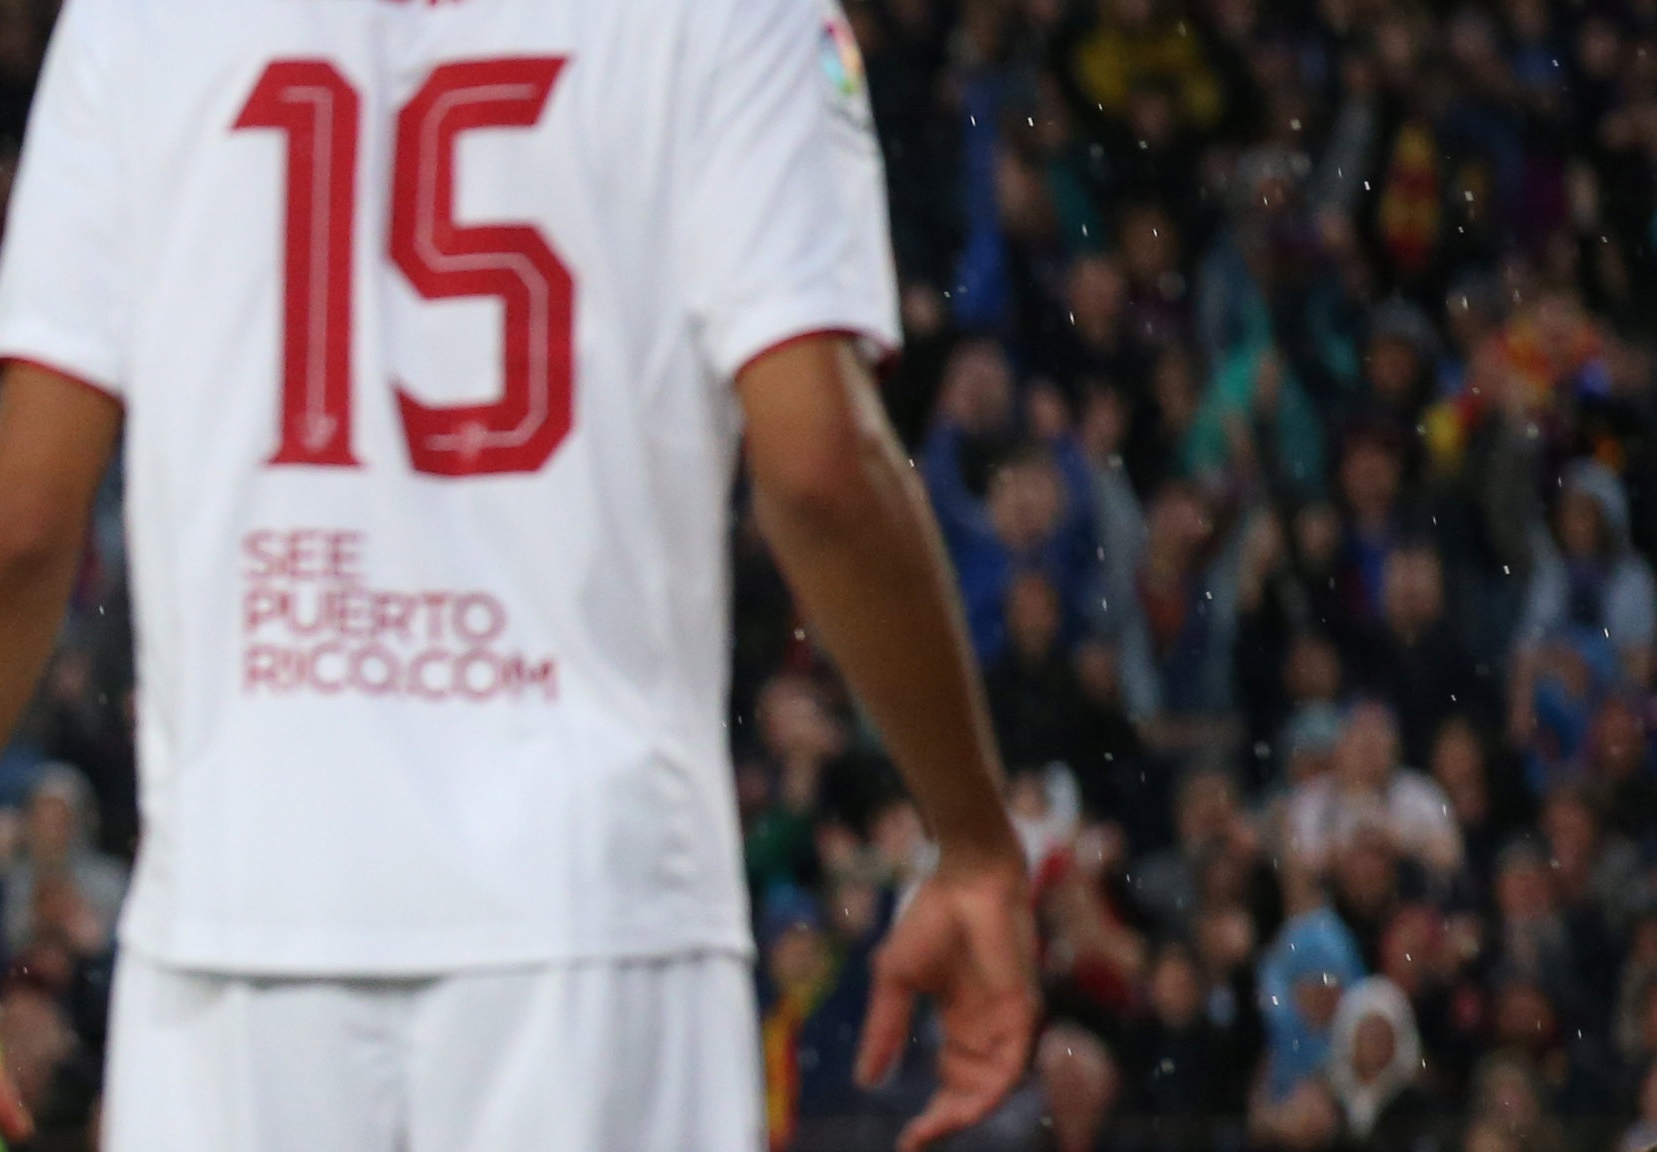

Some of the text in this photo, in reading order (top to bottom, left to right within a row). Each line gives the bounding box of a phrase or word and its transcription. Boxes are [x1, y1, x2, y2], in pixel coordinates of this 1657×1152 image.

[230, 53, 576, 477] 15
[241, 530, 365, 580] SEE
[242, 587, 507, 645] PUERTO
